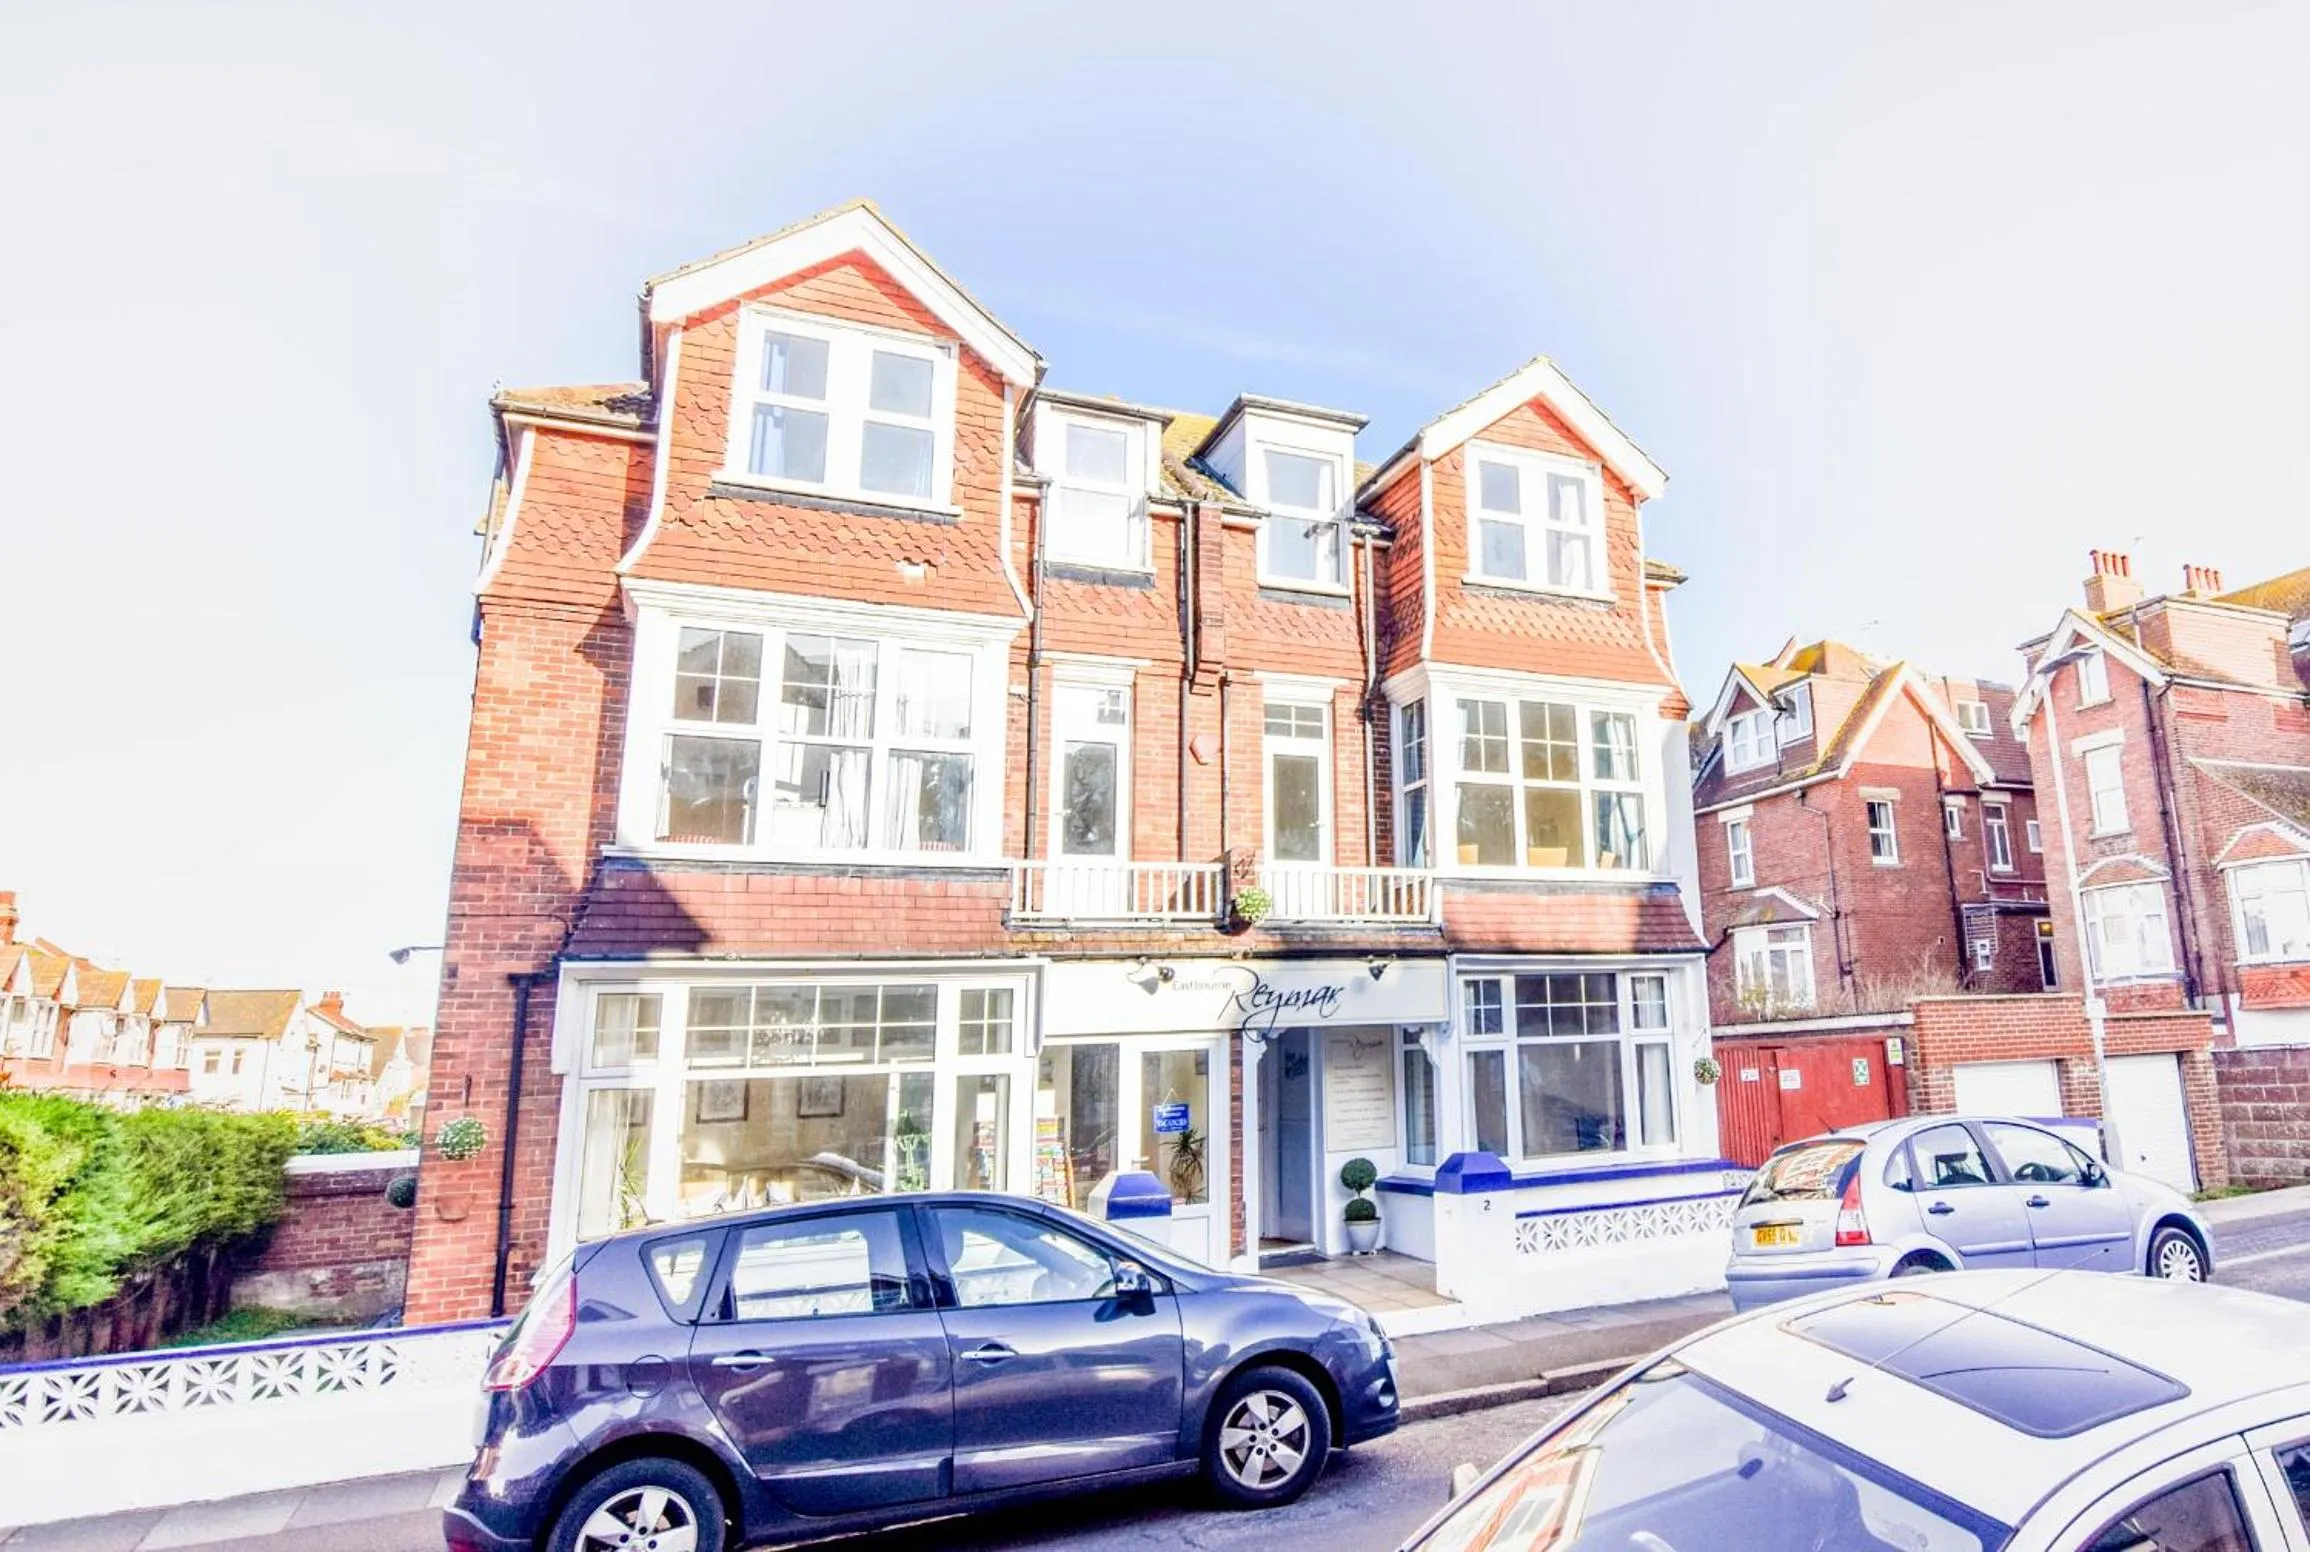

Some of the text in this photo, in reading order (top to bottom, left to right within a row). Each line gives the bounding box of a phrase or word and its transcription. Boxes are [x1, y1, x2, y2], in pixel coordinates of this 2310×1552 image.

[1171, 965, 1346, 1043] Eastbourne Reymar
[1483, 1199, 1491, 1211] 2
